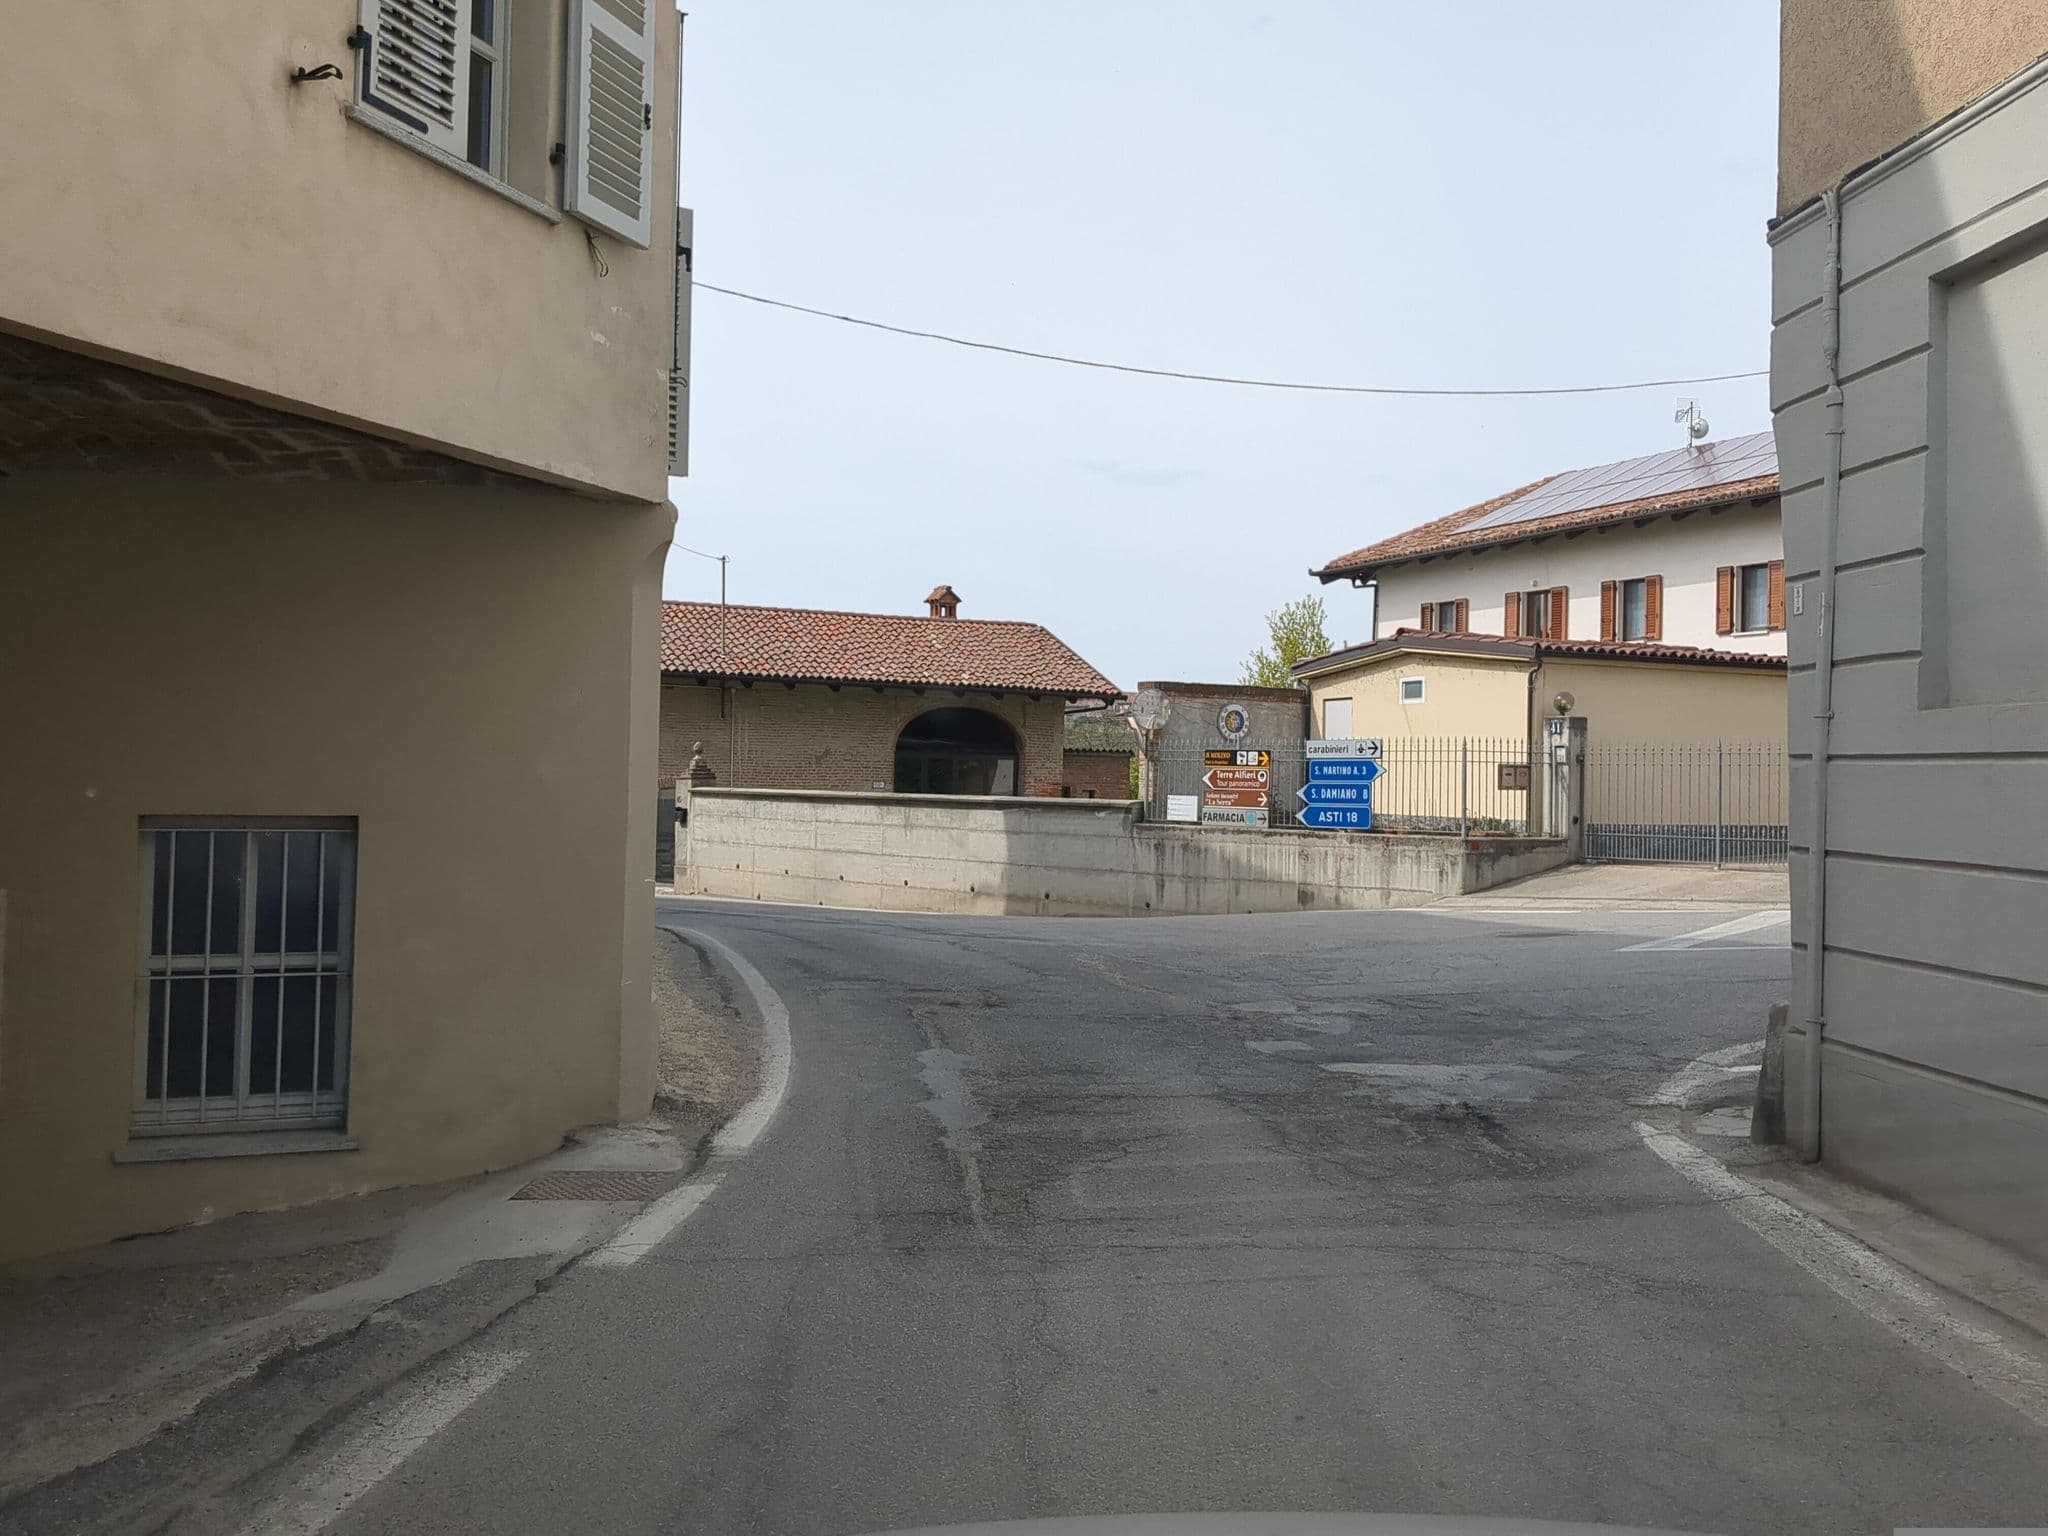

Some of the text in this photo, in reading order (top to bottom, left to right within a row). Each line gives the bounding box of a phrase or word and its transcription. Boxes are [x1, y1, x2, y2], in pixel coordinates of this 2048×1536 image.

[1308, 744, 1349, 754] carabinieri
[1216, 771, 1256, 779] Terre Alfieri
[1314, 766, 1321, 775] S.
[1323, 766, 1351, 775] MARTINO
[1362, 766, 1367, 775] 3
[1229, 780, 1261, 788] panoramico
[1311, 788, 1368, 799] S. DAMIANO 8
[1203, 812, 1245, 823] FARMACIA
[1318, 811, 1358, 823] ASTI 18
